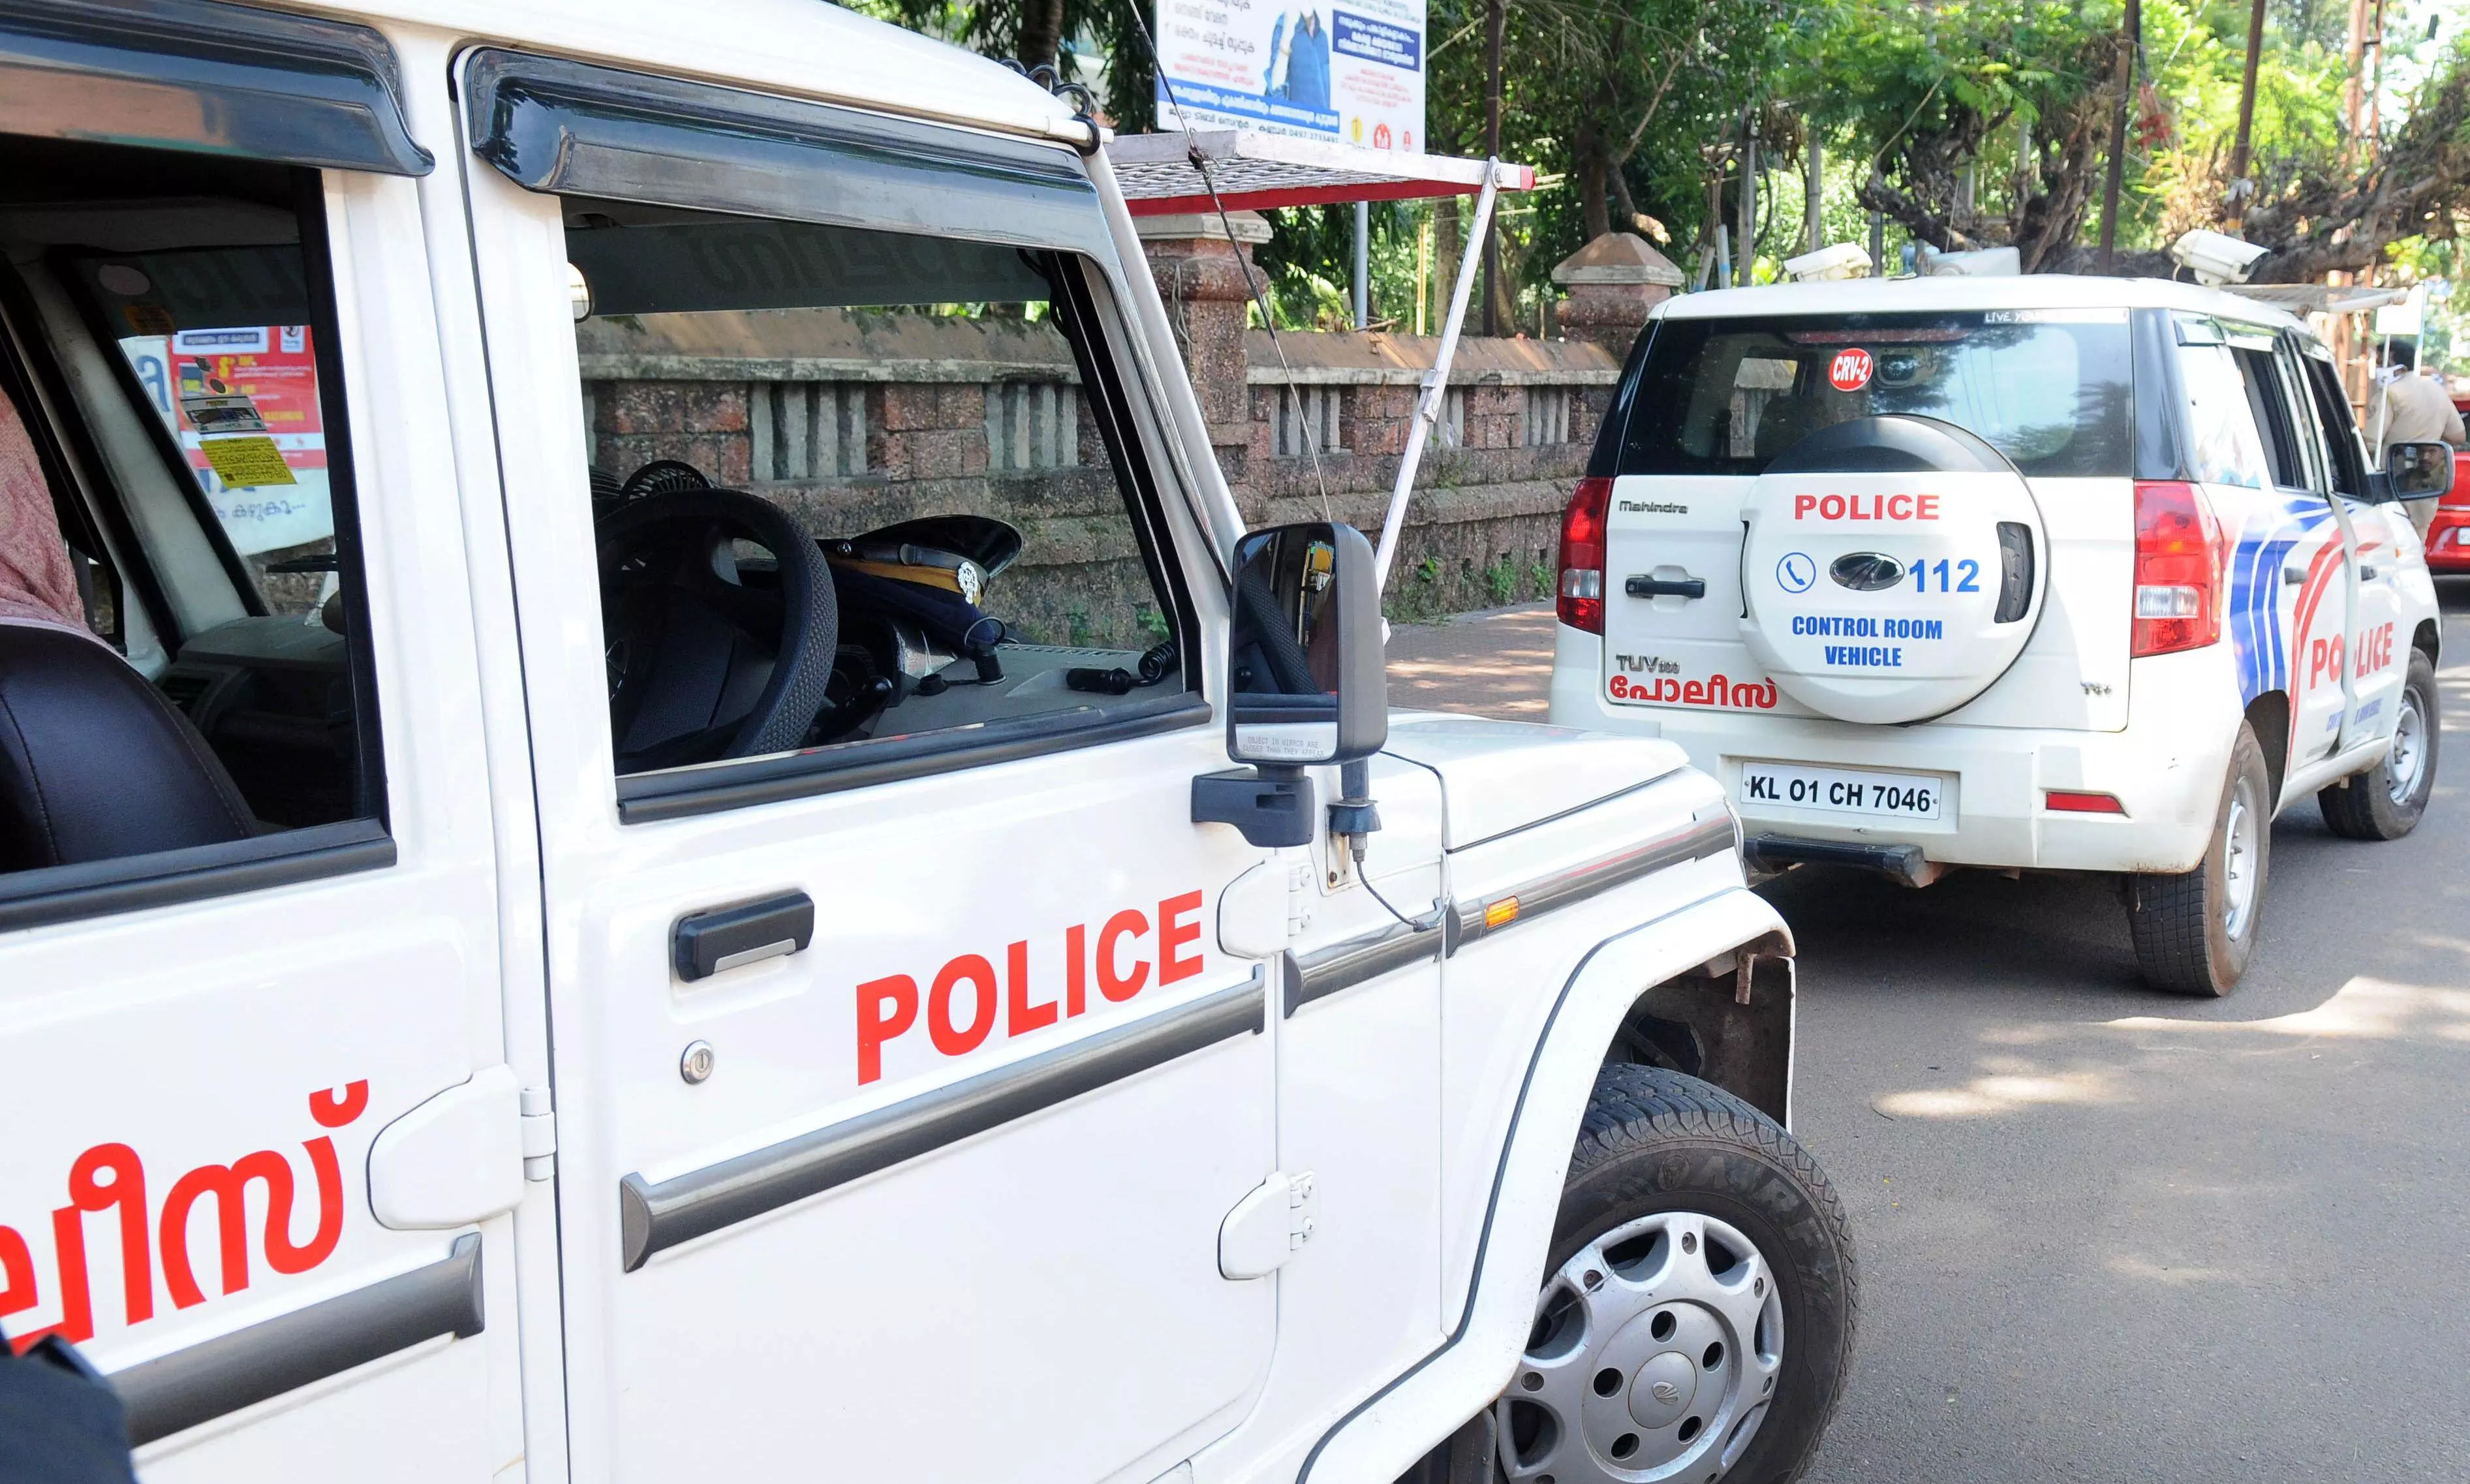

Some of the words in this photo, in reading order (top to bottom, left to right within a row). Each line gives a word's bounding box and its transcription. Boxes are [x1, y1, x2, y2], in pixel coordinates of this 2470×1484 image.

[1984, 312, 2012, 324] LIVE
[1833, 356, 1870, 381] CRV-2
[1796, 495, 1938, 520] POLICE
[1909, 559, 1980, 593] 112
[1792, 616, 1878, 638] CONTROL
[1884, 617, 1943, 640] ROOM
[1825, 645, 1902, 668] VEHICLE
[2309, 622, 2394, 690] POLICE
[1609, 674, 1778, 709] പോലീസ്
[1750, 776, 1780, 799] KL
[1829, 782, 1863, 807] CH
[1872, 786, 1930, 812] 7046
[856, 889, 1203, 1086] POLICE
